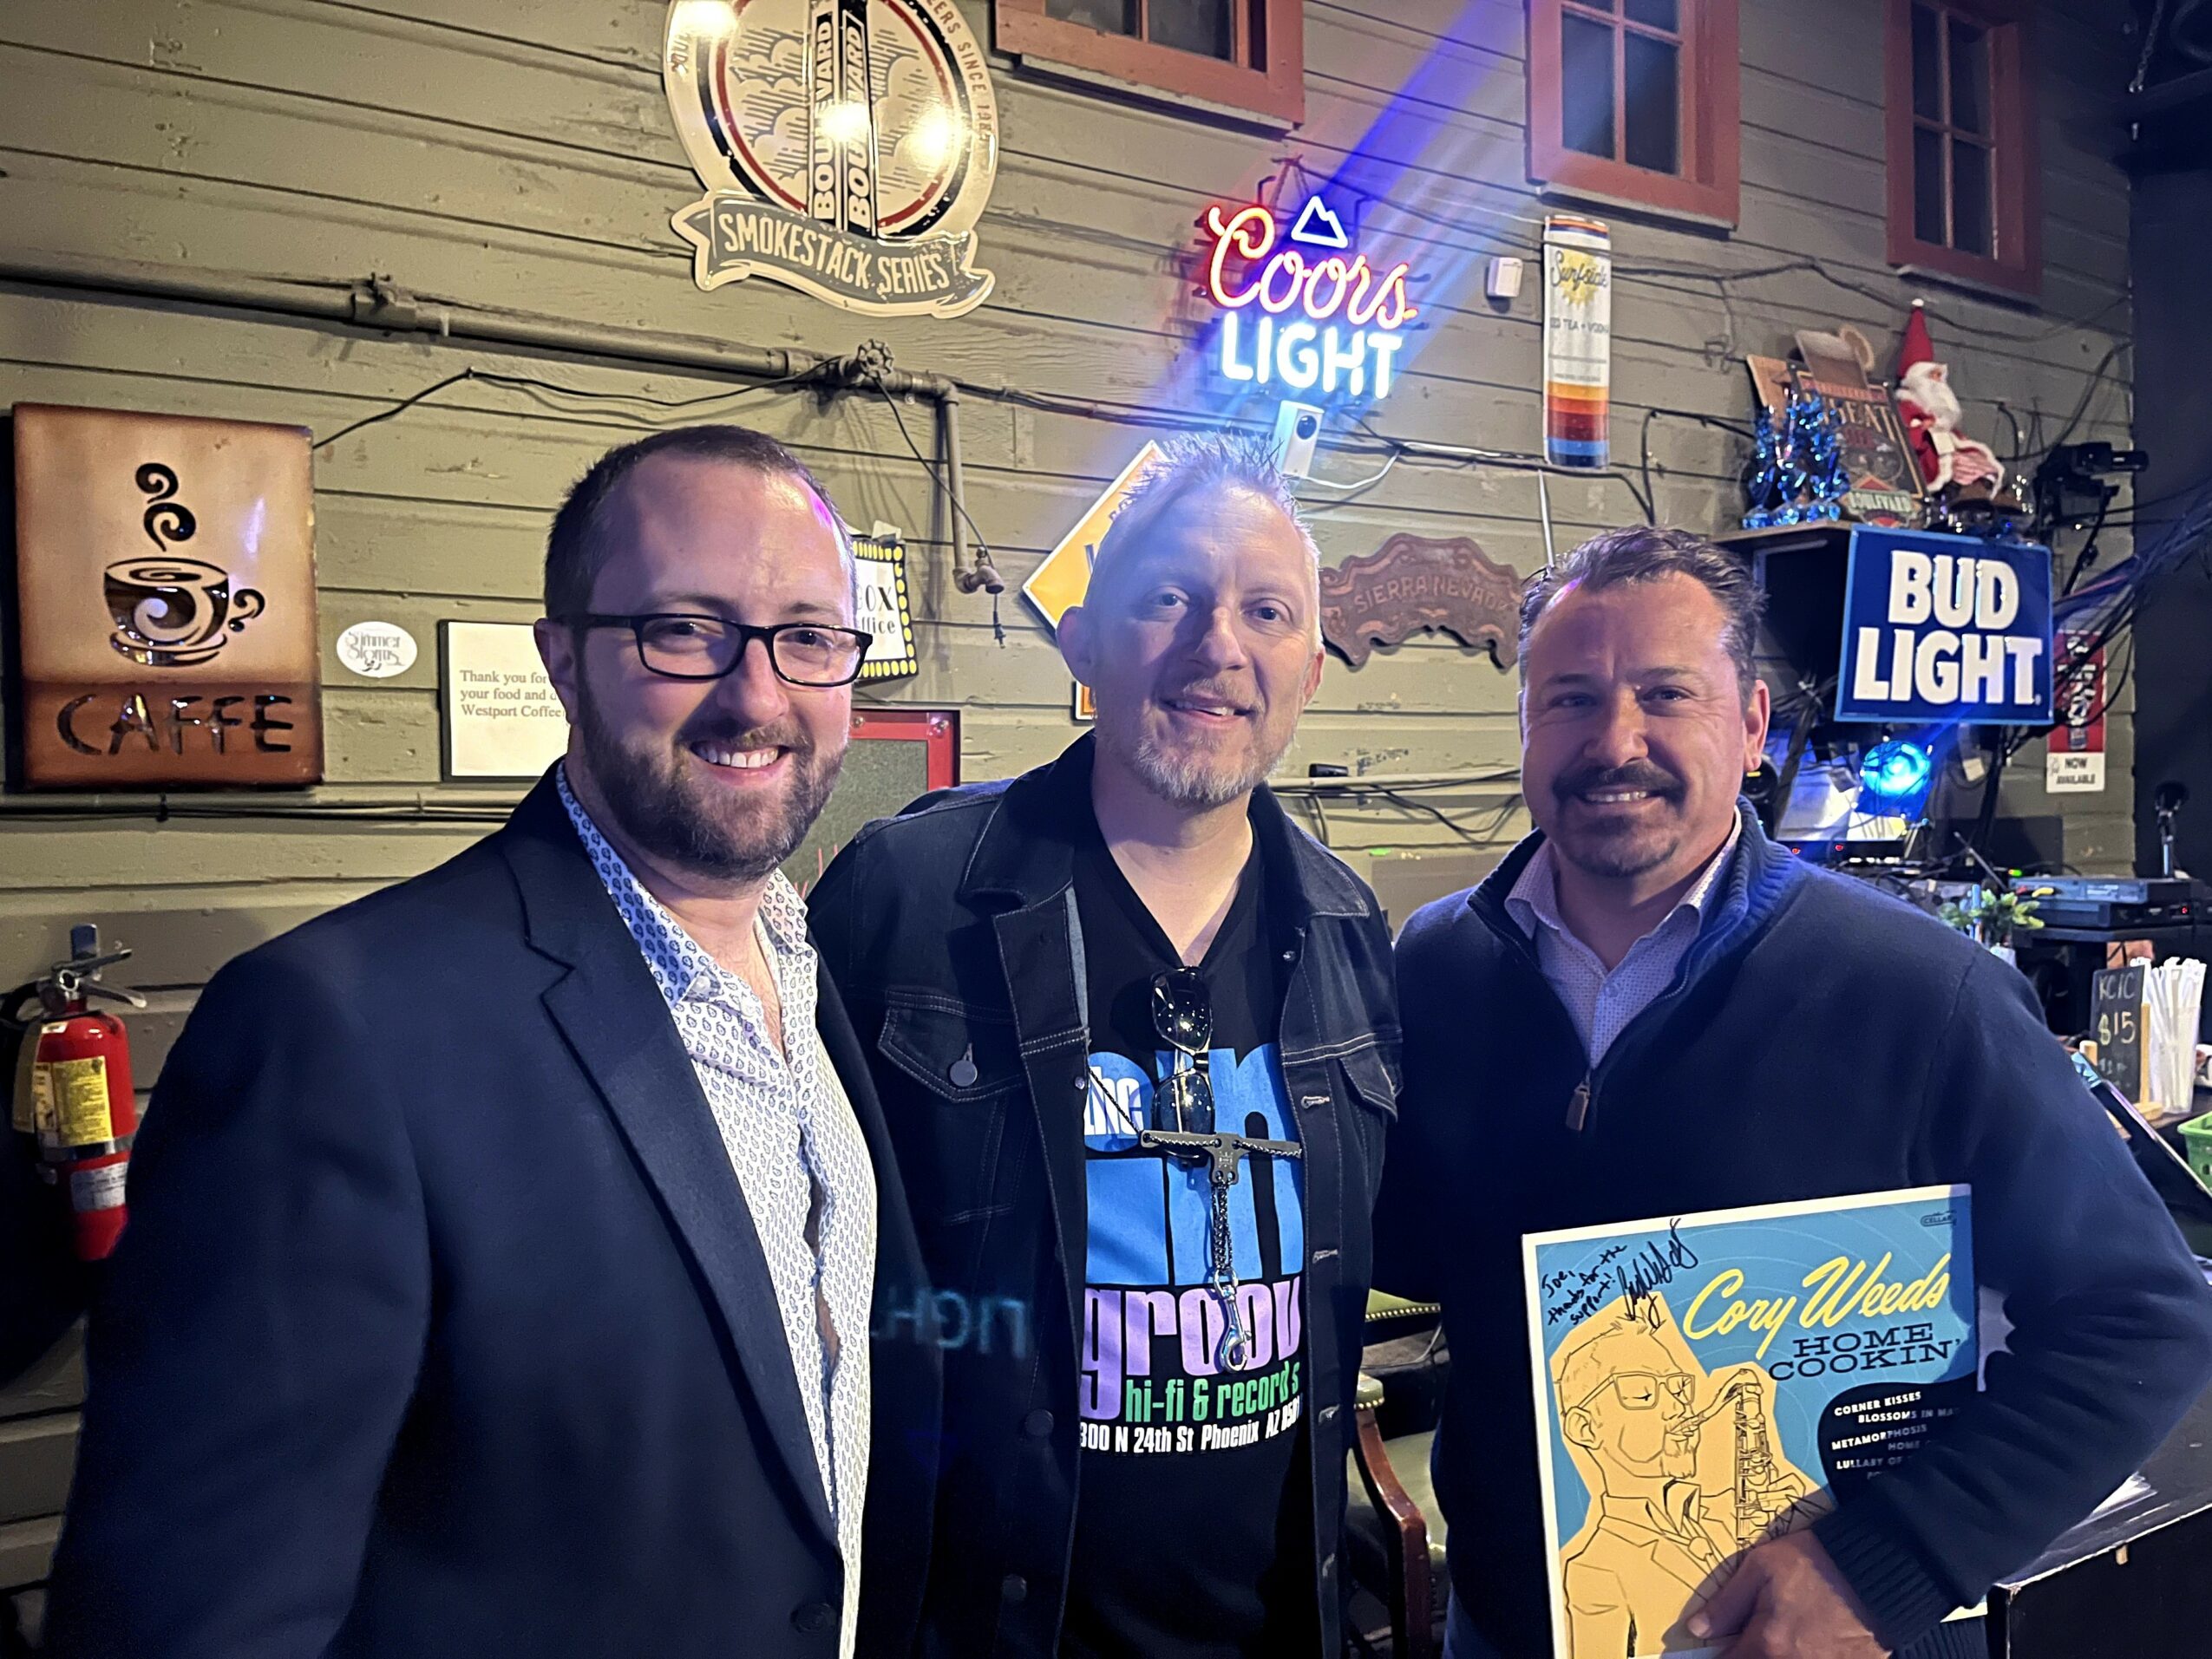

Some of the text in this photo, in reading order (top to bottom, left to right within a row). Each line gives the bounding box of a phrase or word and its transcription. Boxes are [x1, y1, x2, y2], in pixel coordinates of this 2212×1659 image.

[957, 42, 987, 93] SINCE
[718, 212, 950, 295] SMOKESTACK SERIES
[1207, 205, 1418, 330] Coors
[1221, 310, 1404, 400] LIGHT
[1353, 575, 1429, 614] SIERRA
[1888, 550, 2019, 630] BUD
[459, 669, 546, 686] Thank you for
[1853, 626, 2043, 705] LIGHT
[460, 689, 489, 702] your
[493, 688, 520, 700] food
[524, 689, 546, 700] and
[461, 703, 562, 720] Westport Coffee
[56, 693, 293, 756] CAFFE
[2065, 757, 2088, 770] NOW
[2098, 1010, 2137, 1046] $15
[1682, 1268, 1797, 1361] Cory
[1799, 1251, 1952, 1329] Weeds
[1768, 1338, 1961, 1381] COOKIN'
[1792, 1322, 1934, 1359] HOME
[1125, 1360, 1299, 1422] hi-fi & records
[1834, 1390, 1922, 1417] CORNER KISSES
[1116, 1426, 1129, 1453] N
[1133, 1427, 1172, 1453] 24th
[1176, 1425, 1194, 1453] St
[1201, 1420, 1260, 1451] Phoenix
[1265, 1411, 1280, 1440] AZ
[1831, 1423, 1927, 1451] METAMORPHOSIS
[1857, 1409, 1917, 1425] BLOSSOMS
[1836, 1457, 1884, 1470] LULLABY
